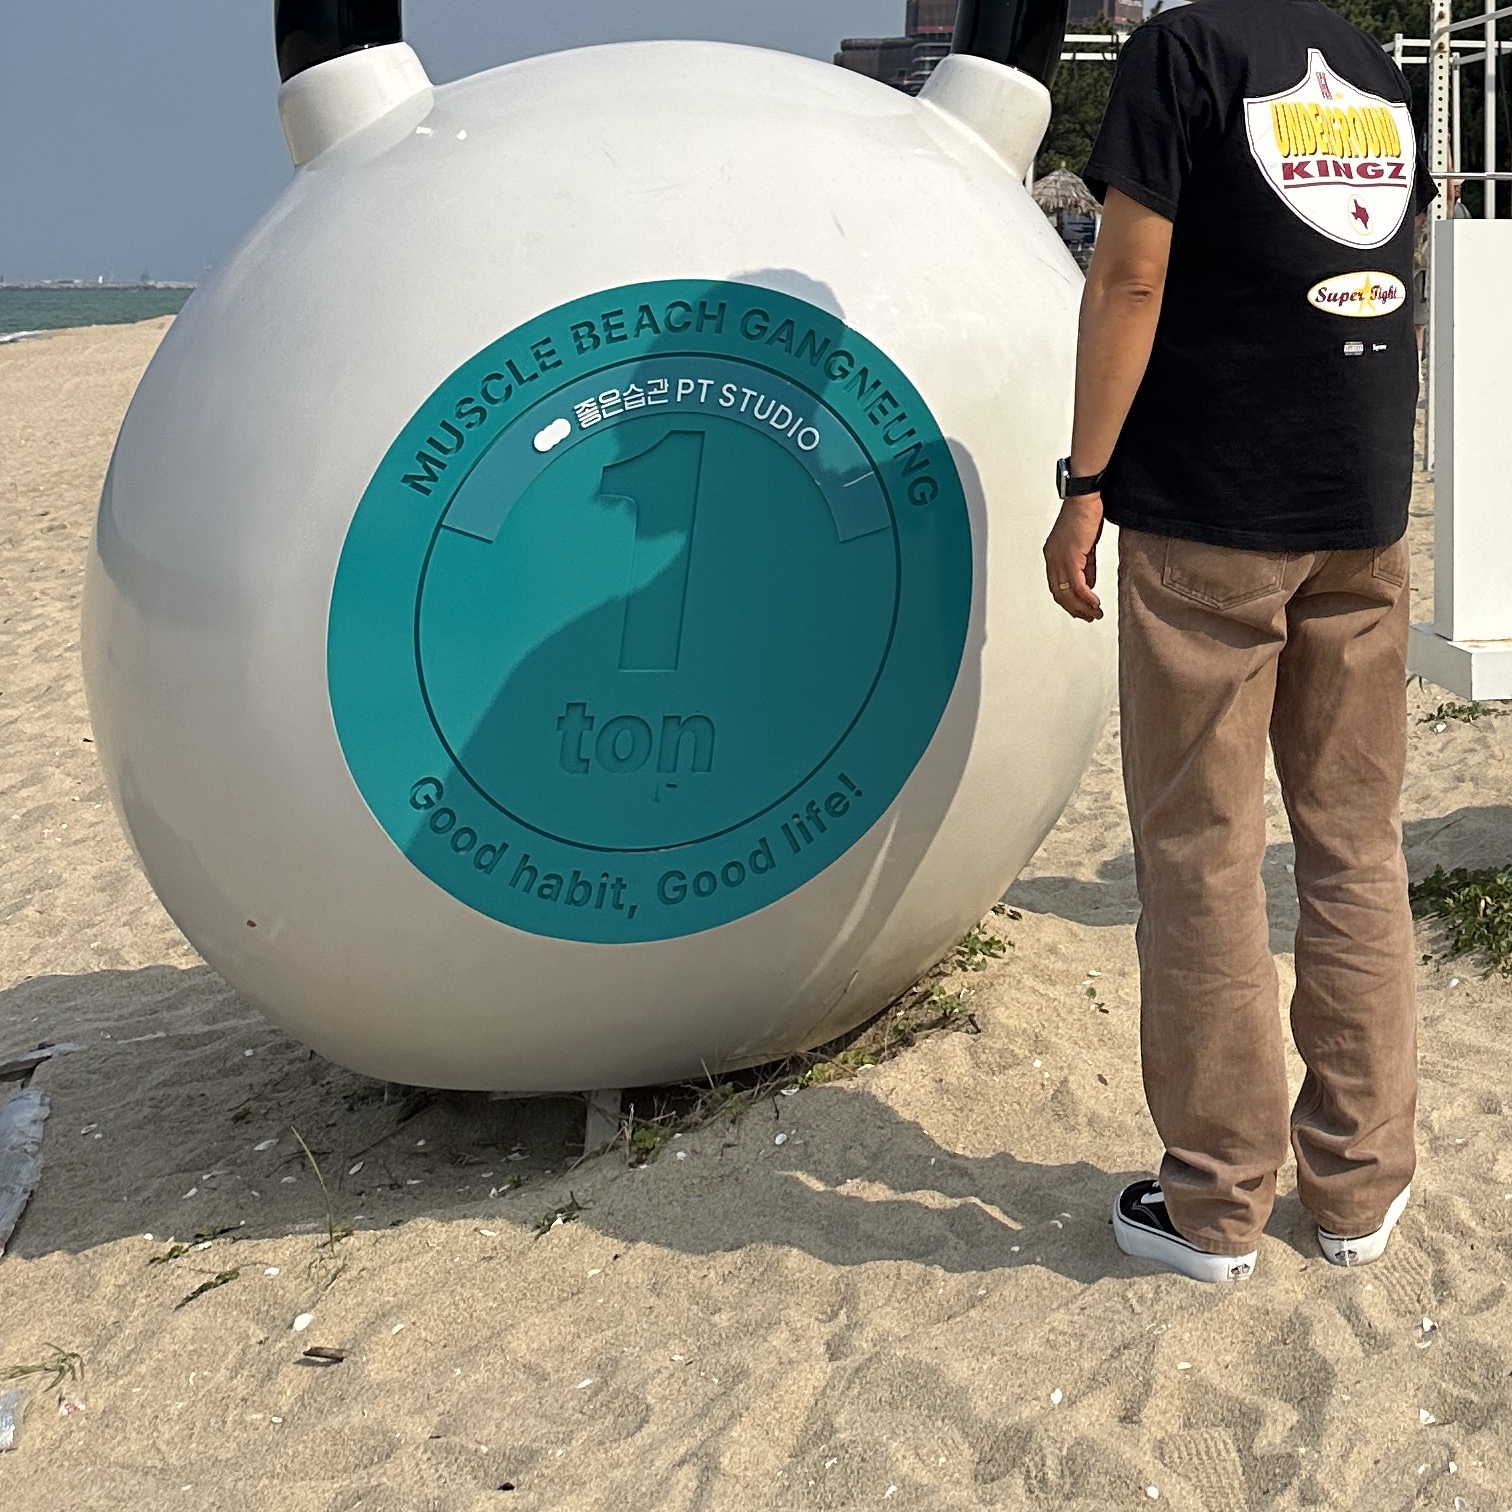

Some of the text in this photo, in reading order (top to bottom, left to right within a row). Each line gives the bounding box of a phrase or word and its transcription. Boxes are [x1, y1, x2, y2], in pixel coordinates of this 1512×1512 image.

[1282, 160, 1406, 180] KINGZ
[1315, 287, 1365, 306] Super
[401, 299, 939, 507] MUSCLE BEACH GANGNEUNG
[574, 378, 821, 451] 좋은습관 PT STUDIO
[599, 429, 706, 672] 1
[556, 700, 717, 775] ton
[408, 770, 866, 921] Good habit, Good life!
